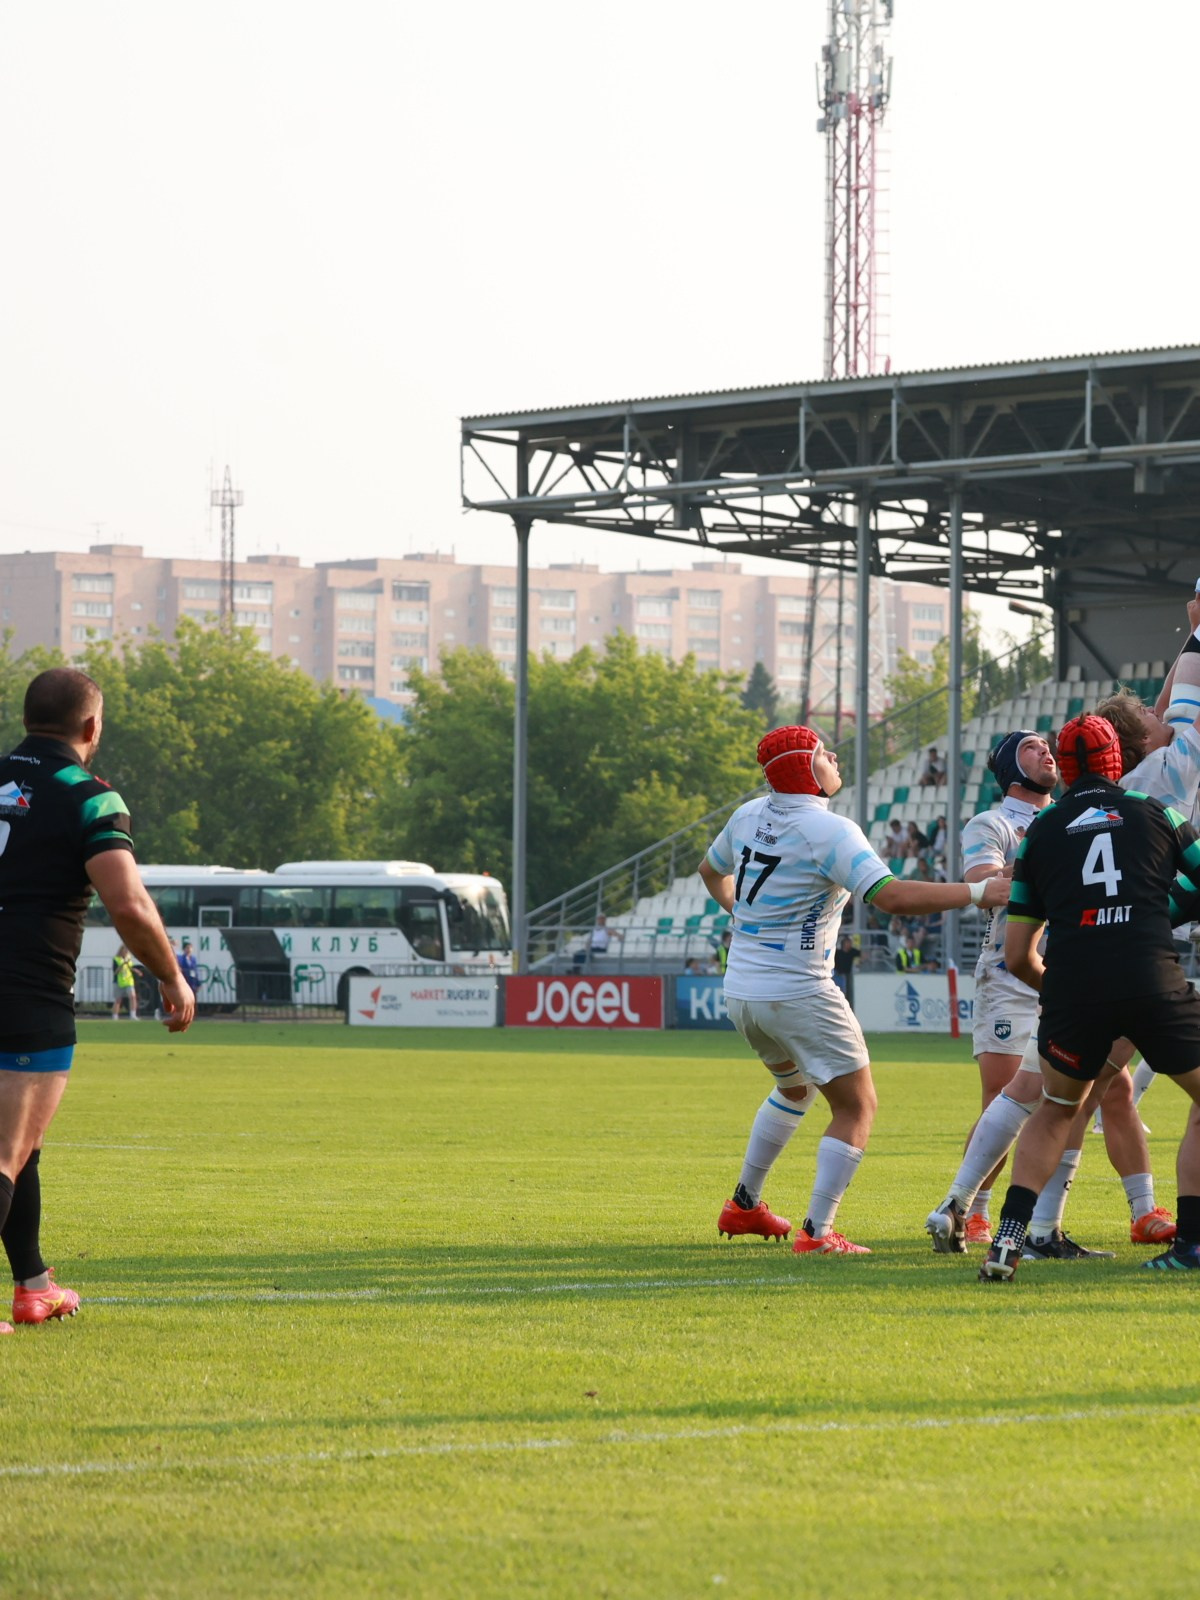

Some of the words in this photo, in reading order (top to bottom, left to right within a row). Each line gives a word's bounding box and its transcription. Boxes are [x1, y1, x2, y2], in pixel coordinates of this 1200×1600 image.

[735, 845, 782, 907] 17
[1081, 832, 1122, 897] 4
[1096, 905, 1133, 926] АГАТ
[311, 936, 379, 953] КЛУБ
